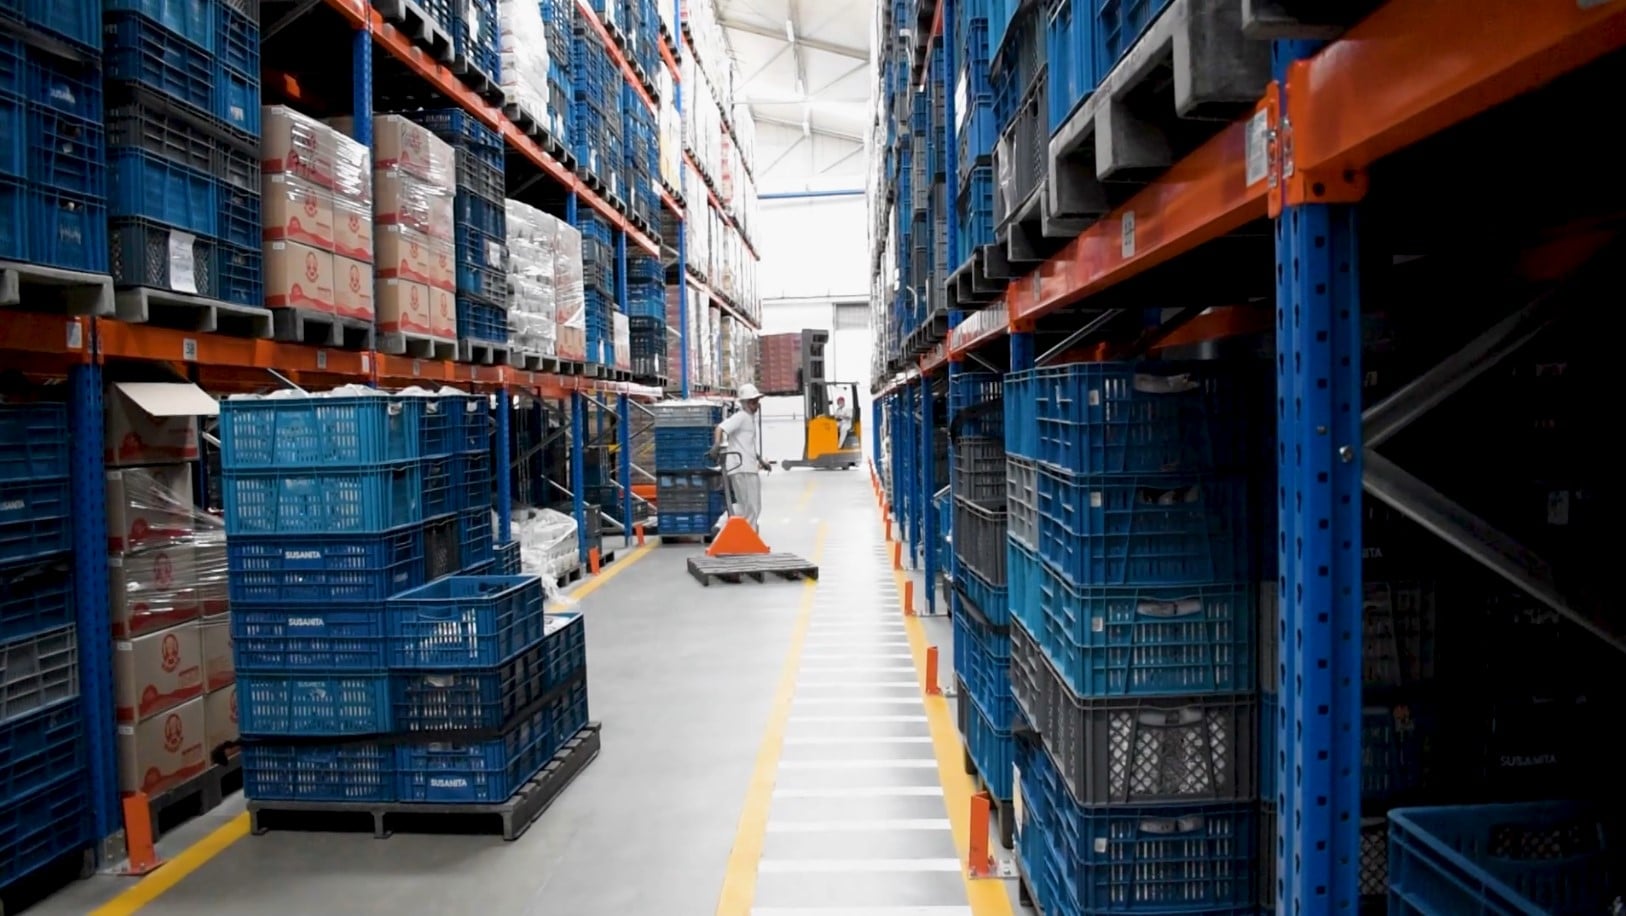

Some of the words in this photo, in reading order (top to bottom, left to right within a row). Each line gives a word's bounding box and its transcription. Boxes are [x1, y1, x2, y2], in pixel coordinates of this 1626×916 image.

[284, 550, 321, 559] SUSANITA
[287, 617, 325, 626] SUSANITA
[430, 778, 468, 787] SUSANITA
